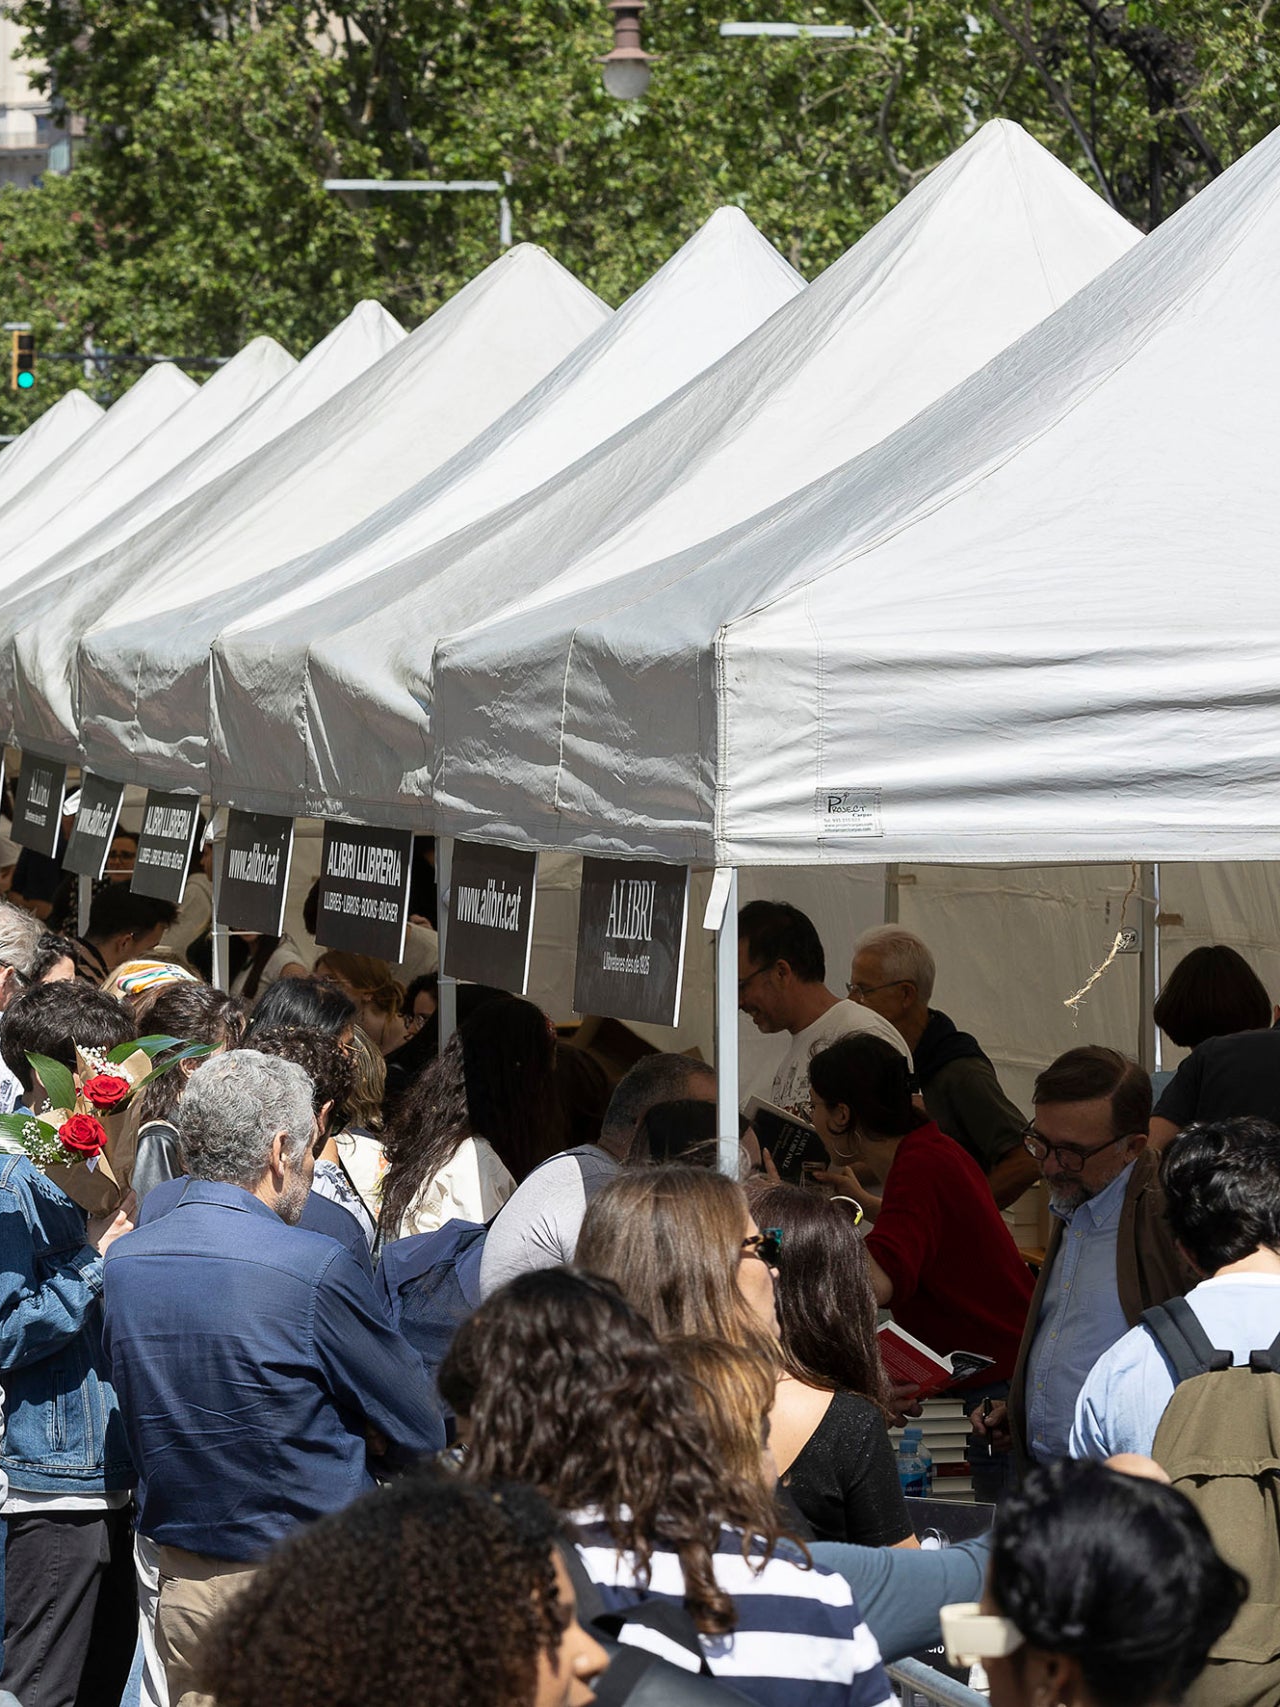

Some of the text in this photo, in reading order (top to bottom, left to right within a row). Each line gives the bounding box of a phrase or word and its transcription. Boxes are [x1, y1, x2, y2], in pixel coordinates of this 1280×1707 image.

[326, 841, 402, 887] ALIBRI LLIBRERIA
[457, 878, 522, 932] www.alibri.cat
[605, 879, 657, 941] ALIBRI
